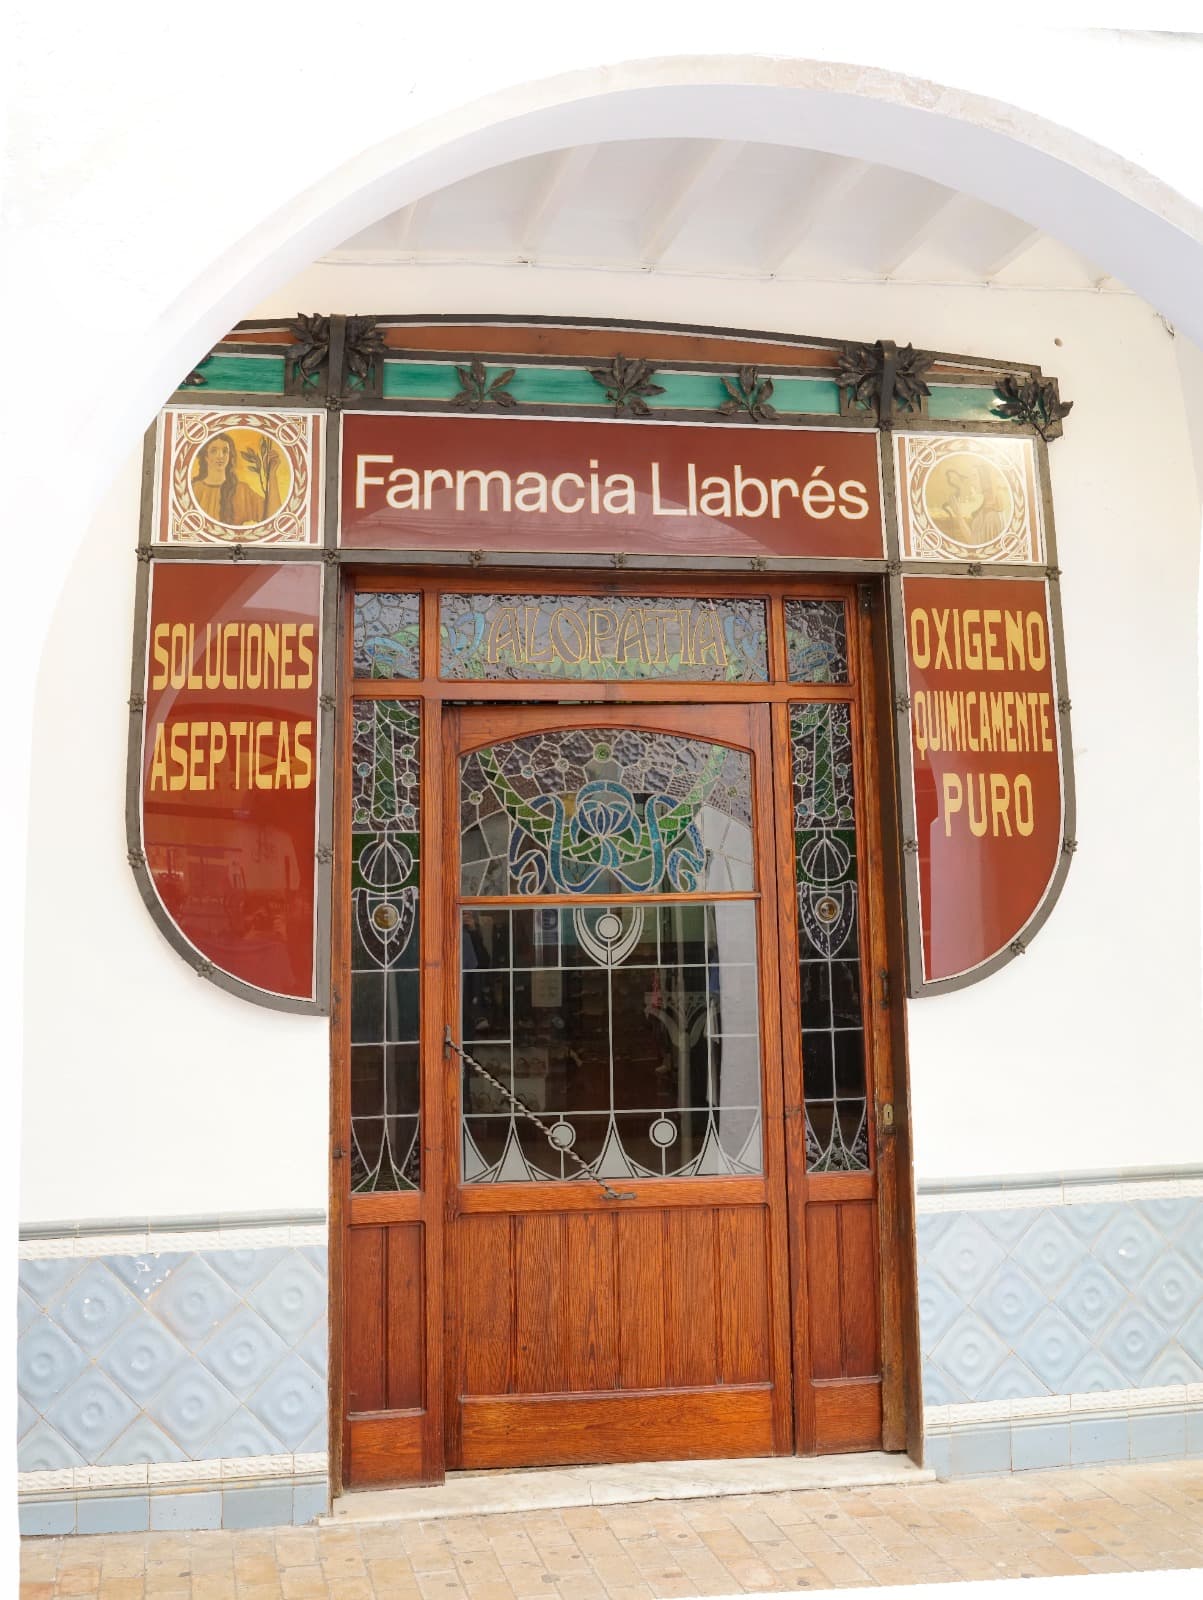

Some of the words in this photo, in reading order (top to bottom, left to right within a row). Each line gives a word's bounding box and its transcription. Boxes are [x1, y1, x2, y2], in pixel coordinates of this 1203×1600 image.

[355, 454, 636, 515] Farmacia
[651, 461, 870, 520] Llabrés
[152, 622, 314, 691] SOLUCIONES
[487, 607, 728, 666] ALOPATIA
[910, 607, 1047, 672] OXIGENO
[150, 720, 312, 792] ASEPTICAS
[913, 690, 1053, 761] QUIMICAMENTE
[942, 772, 1035, 838] PURO
